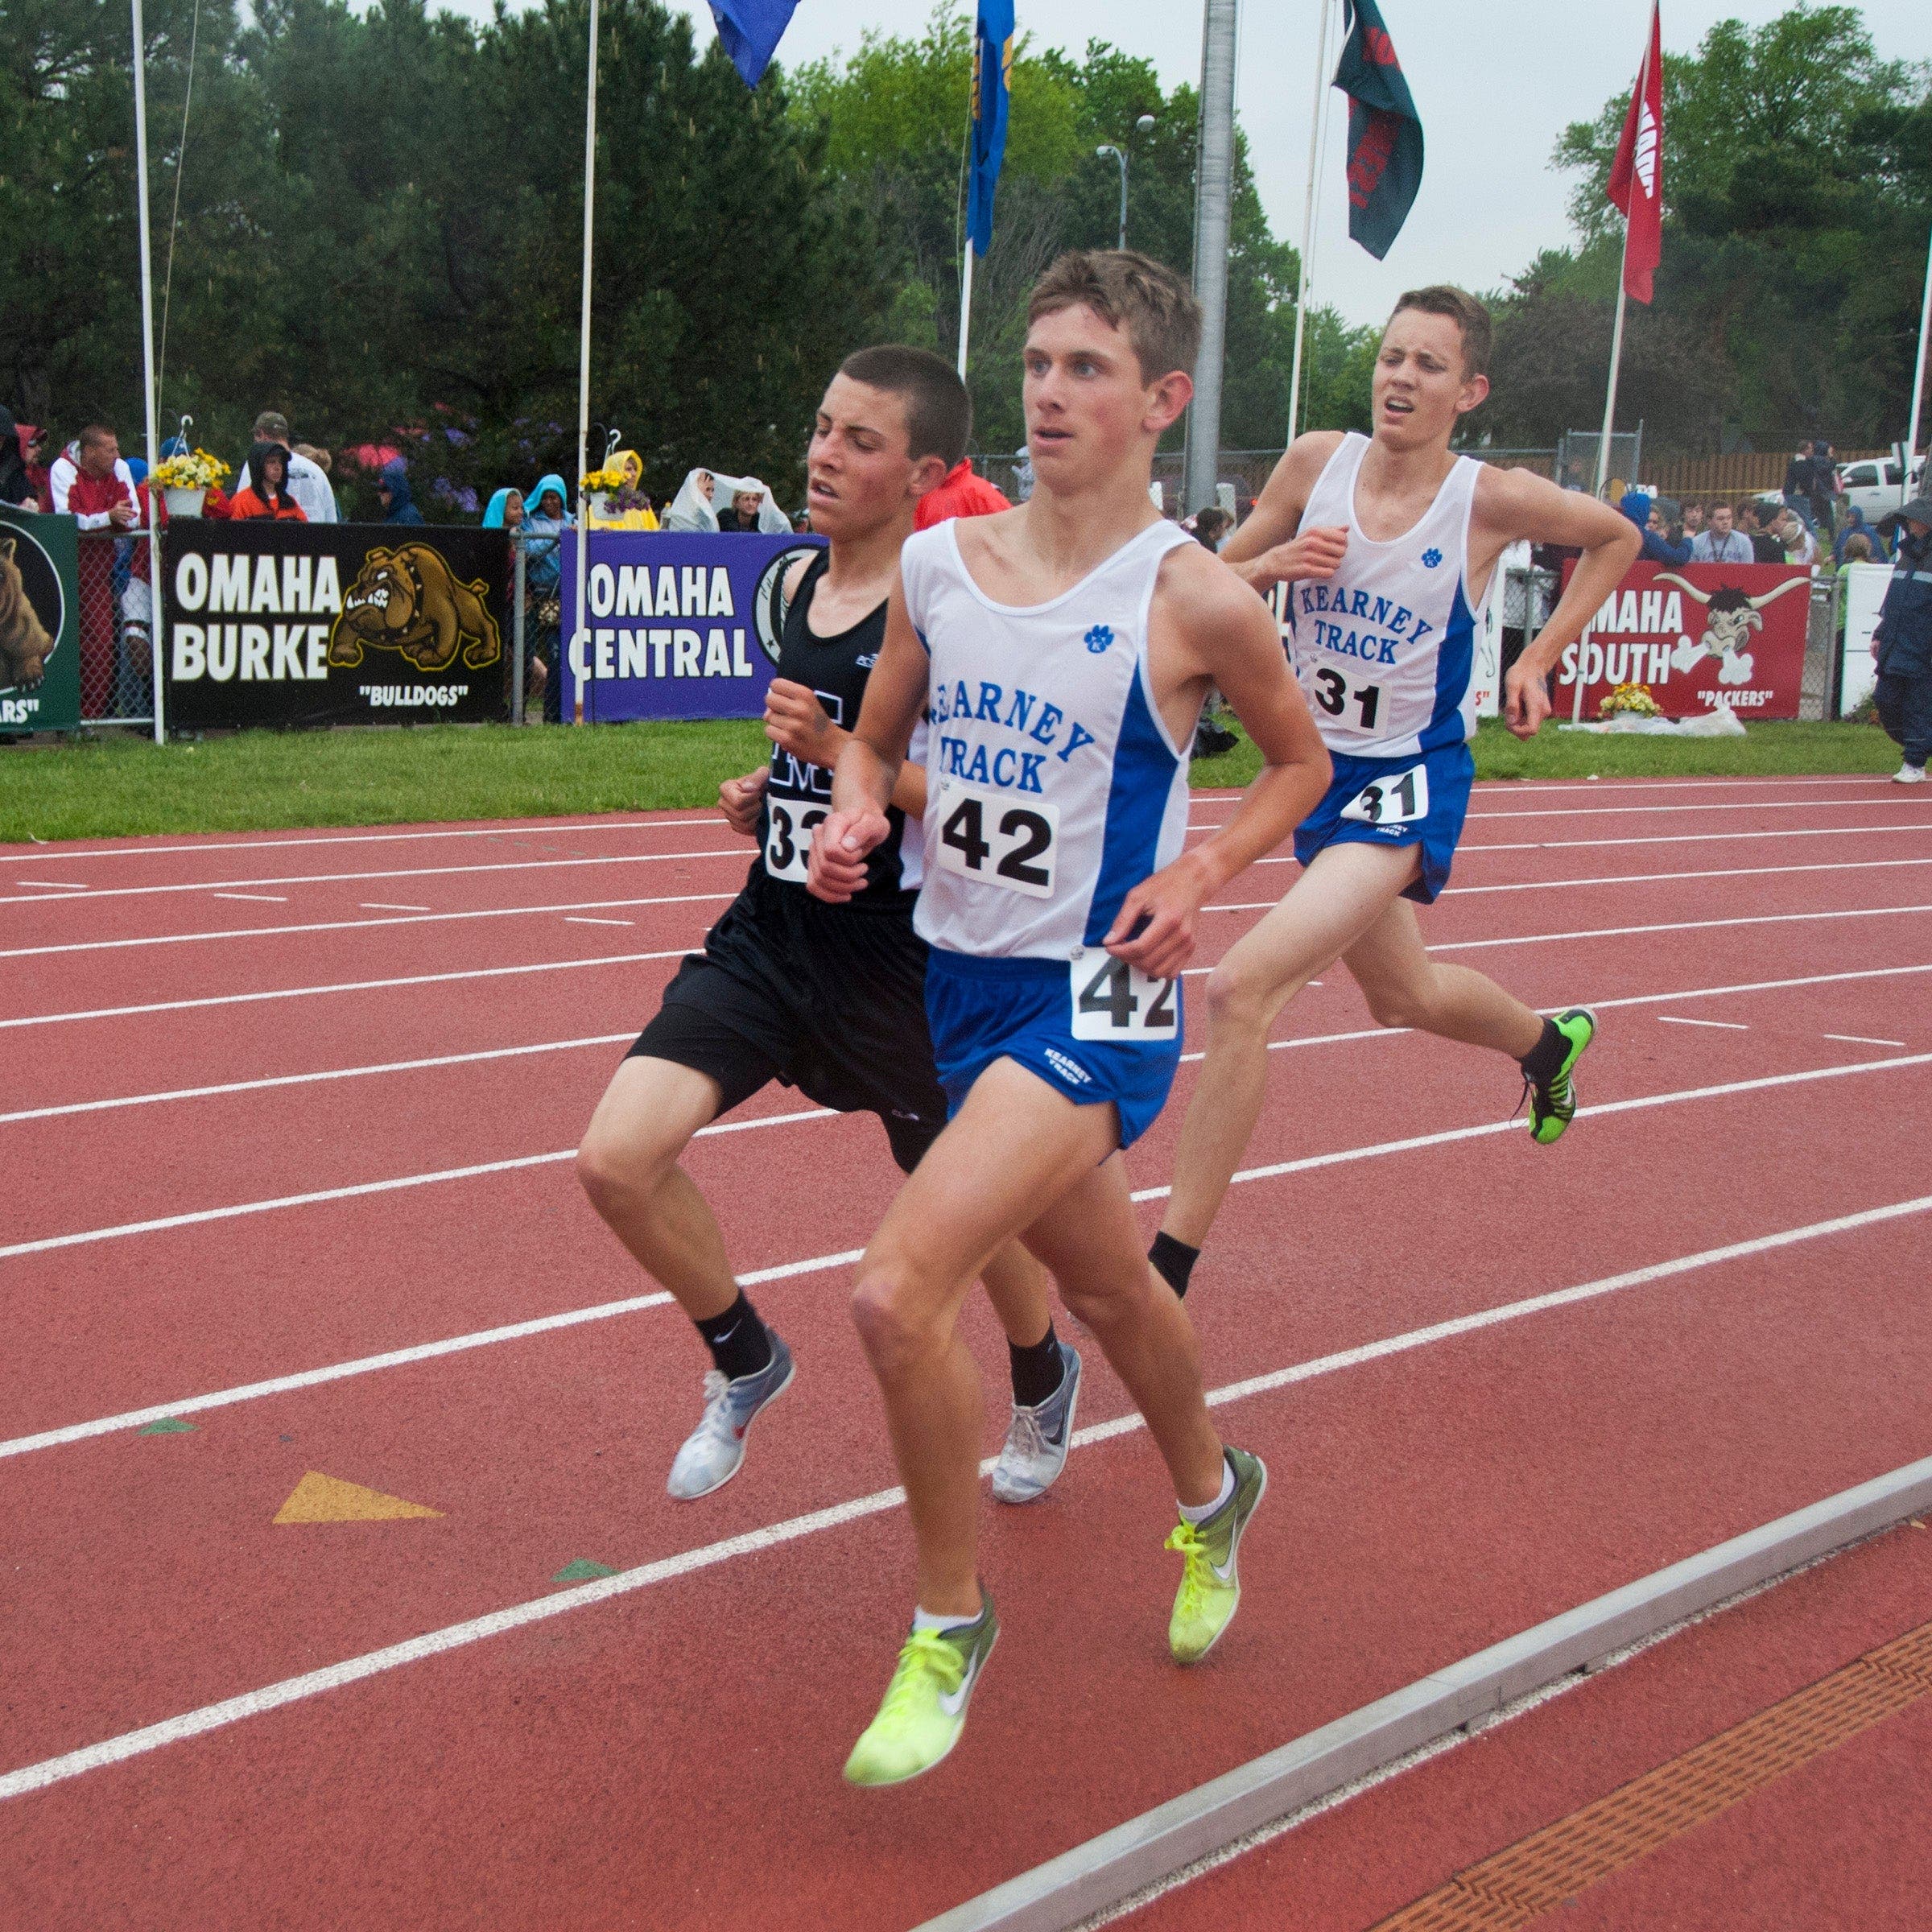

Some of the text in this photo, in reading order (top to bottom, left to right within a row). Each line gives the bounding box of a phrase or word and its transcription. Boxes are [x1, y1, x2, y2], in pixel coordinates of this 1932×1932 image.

[175, 552, 342, 613] OMAHA
[588, 564, 734, 617] OMAHA
[1300, 585, 1433, 645] KEARNEY
[1591, 589, 1683, 634] MAHA
[172, 624, 329, 681] BURKE
[568, 628, 753, 682] CENTRAL
[1315, 619, 1399, 665] TRACK
[0, 699, 39, 724] RS"
[359, 685, 469, 707] "BULLDOGS"
[930, 679, 1096, 763] EARNEY
[1315, 667, 1380, 729] 31
[1697, 690, 1774, 707] "PACKERS"
[939, 736, 1047, 794] TRACK
[1360, 771, 1415, 822] 31
[942, 797, 1052, 887] 42
[1079, 956, 1174, 1028] 42
[1044, 1047, 1092, 1084] KEARNEY
